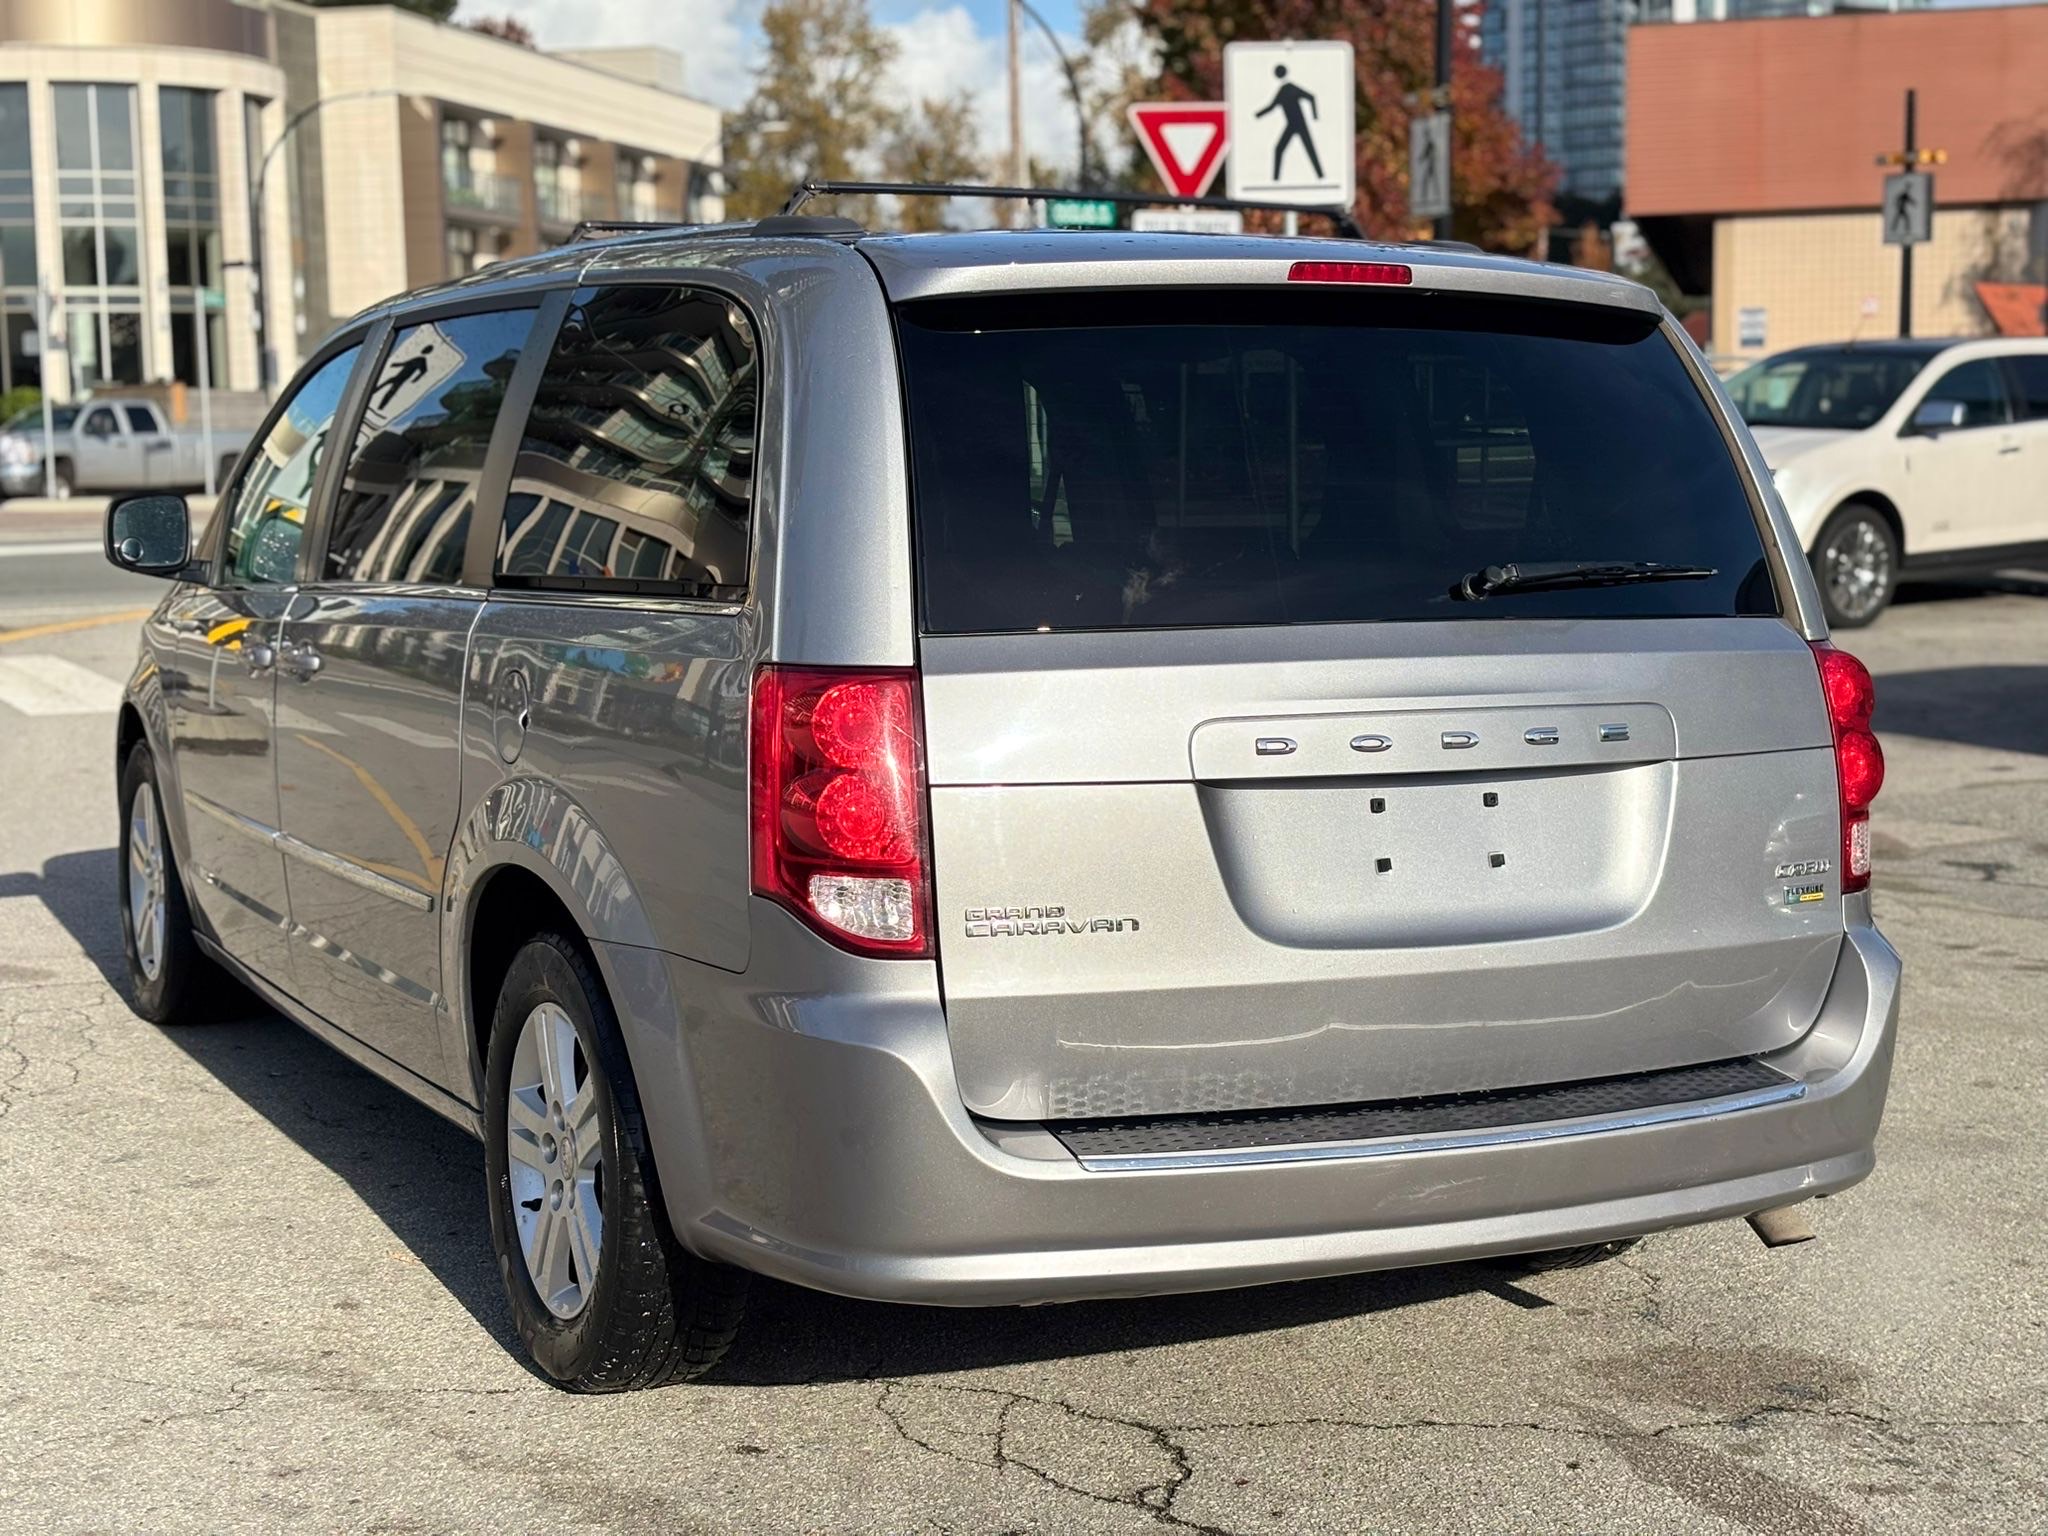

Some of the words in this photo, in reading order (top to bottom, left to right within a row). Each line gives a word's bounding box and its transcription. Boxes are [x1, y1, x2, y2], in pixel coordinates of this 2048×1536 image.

[1255, 723, 1630, 755] DODGE
[965, 905, 1065, 921] GRAND
[965, 918, 1140, 937] CARAVAN
